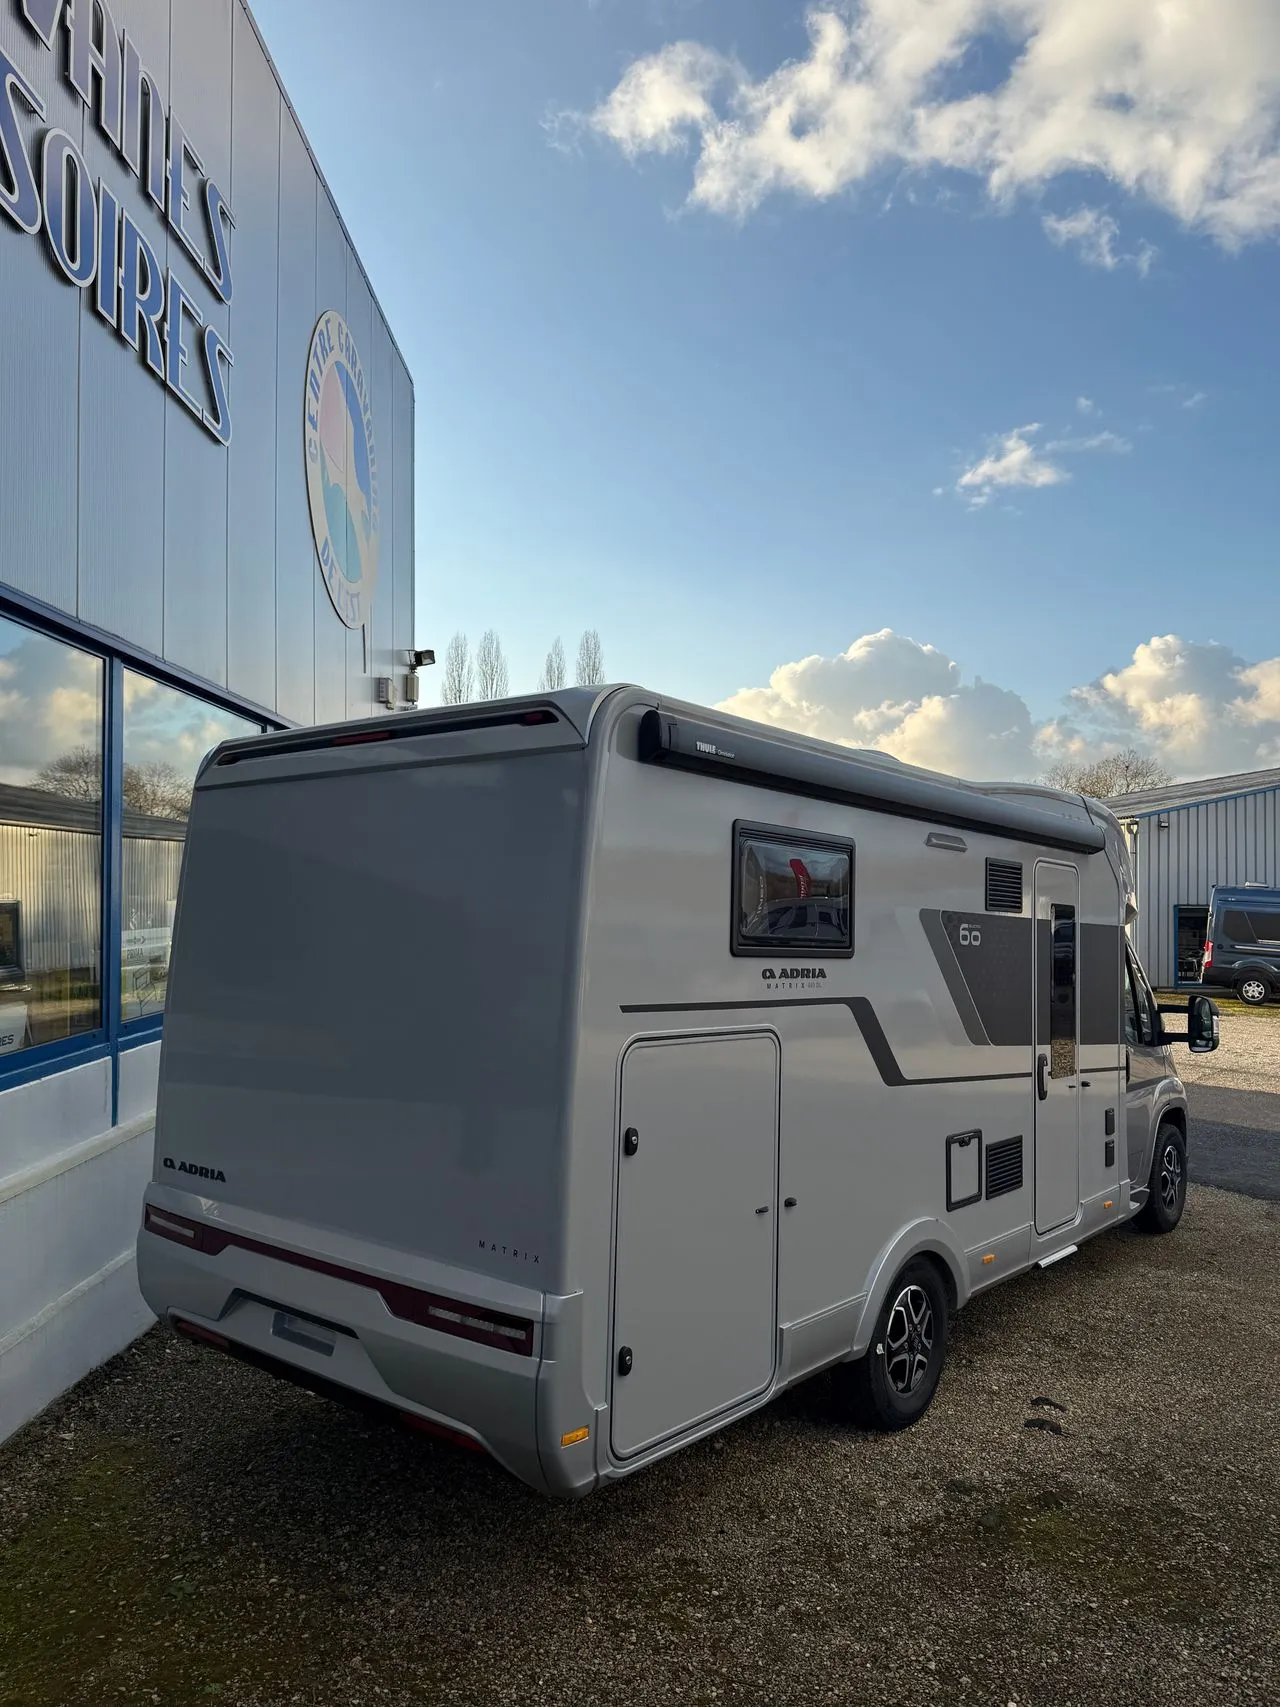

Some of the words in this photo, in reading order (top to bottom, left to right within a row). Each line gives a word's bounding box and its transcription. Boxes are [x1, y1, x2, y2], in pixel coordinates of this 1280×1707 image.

[307, 317, 334, 463] CENTRE
[320, 536, 337, 593] DE
[696, 741, 716, 755] THULE
[960, 923, 981, 946] 60
[779, 968, 827, 979] ADRIA
[178, 1161, 226, 1183] ADRIA
[478, 1240, 540, 1264] MATRIX
